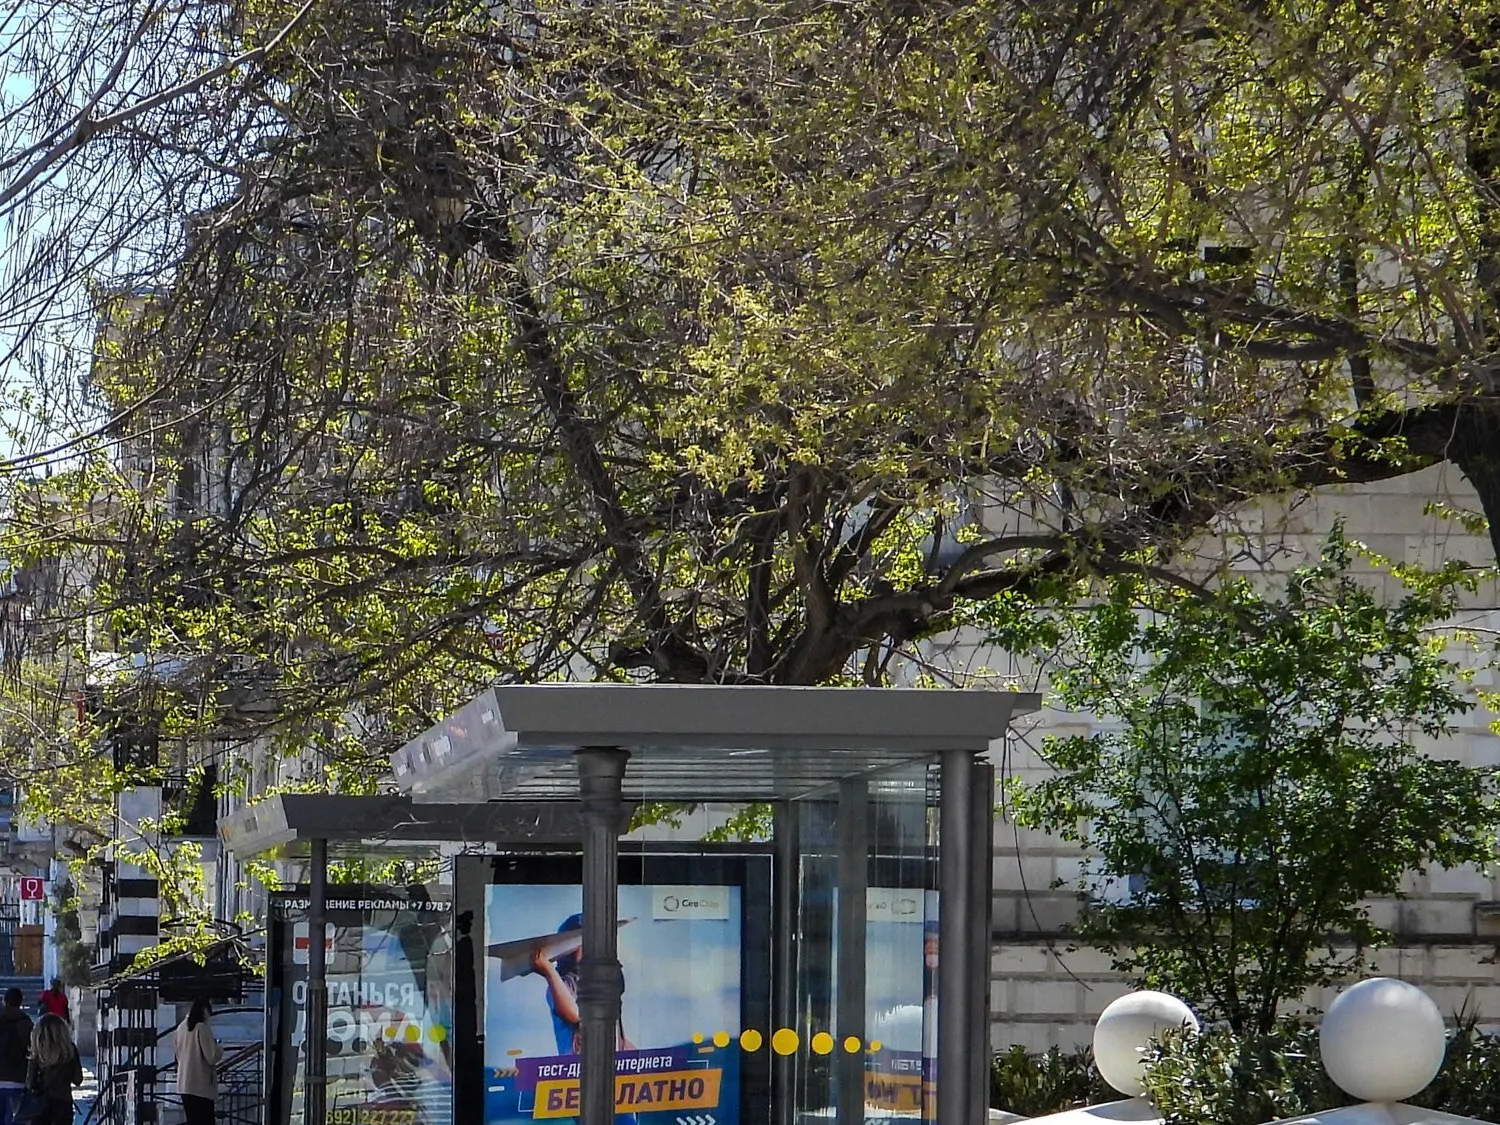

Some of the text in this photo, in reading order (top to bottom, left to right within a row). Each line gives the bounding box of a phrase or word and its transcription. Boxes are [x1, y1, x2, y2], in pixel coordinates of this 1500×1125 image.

[284, 899, 356, 910] РАЗМЕНИЕ
[358, 899, 409, 910] РЕКЛАМЫ
[411, 901, 422, 911] +7
[292, 980, 415, 1007] ОТАНЬСЯ
[614, 1054, 673, 1074] нтернета
[546, 1077, 705, 1112] БЕЛАТНО
